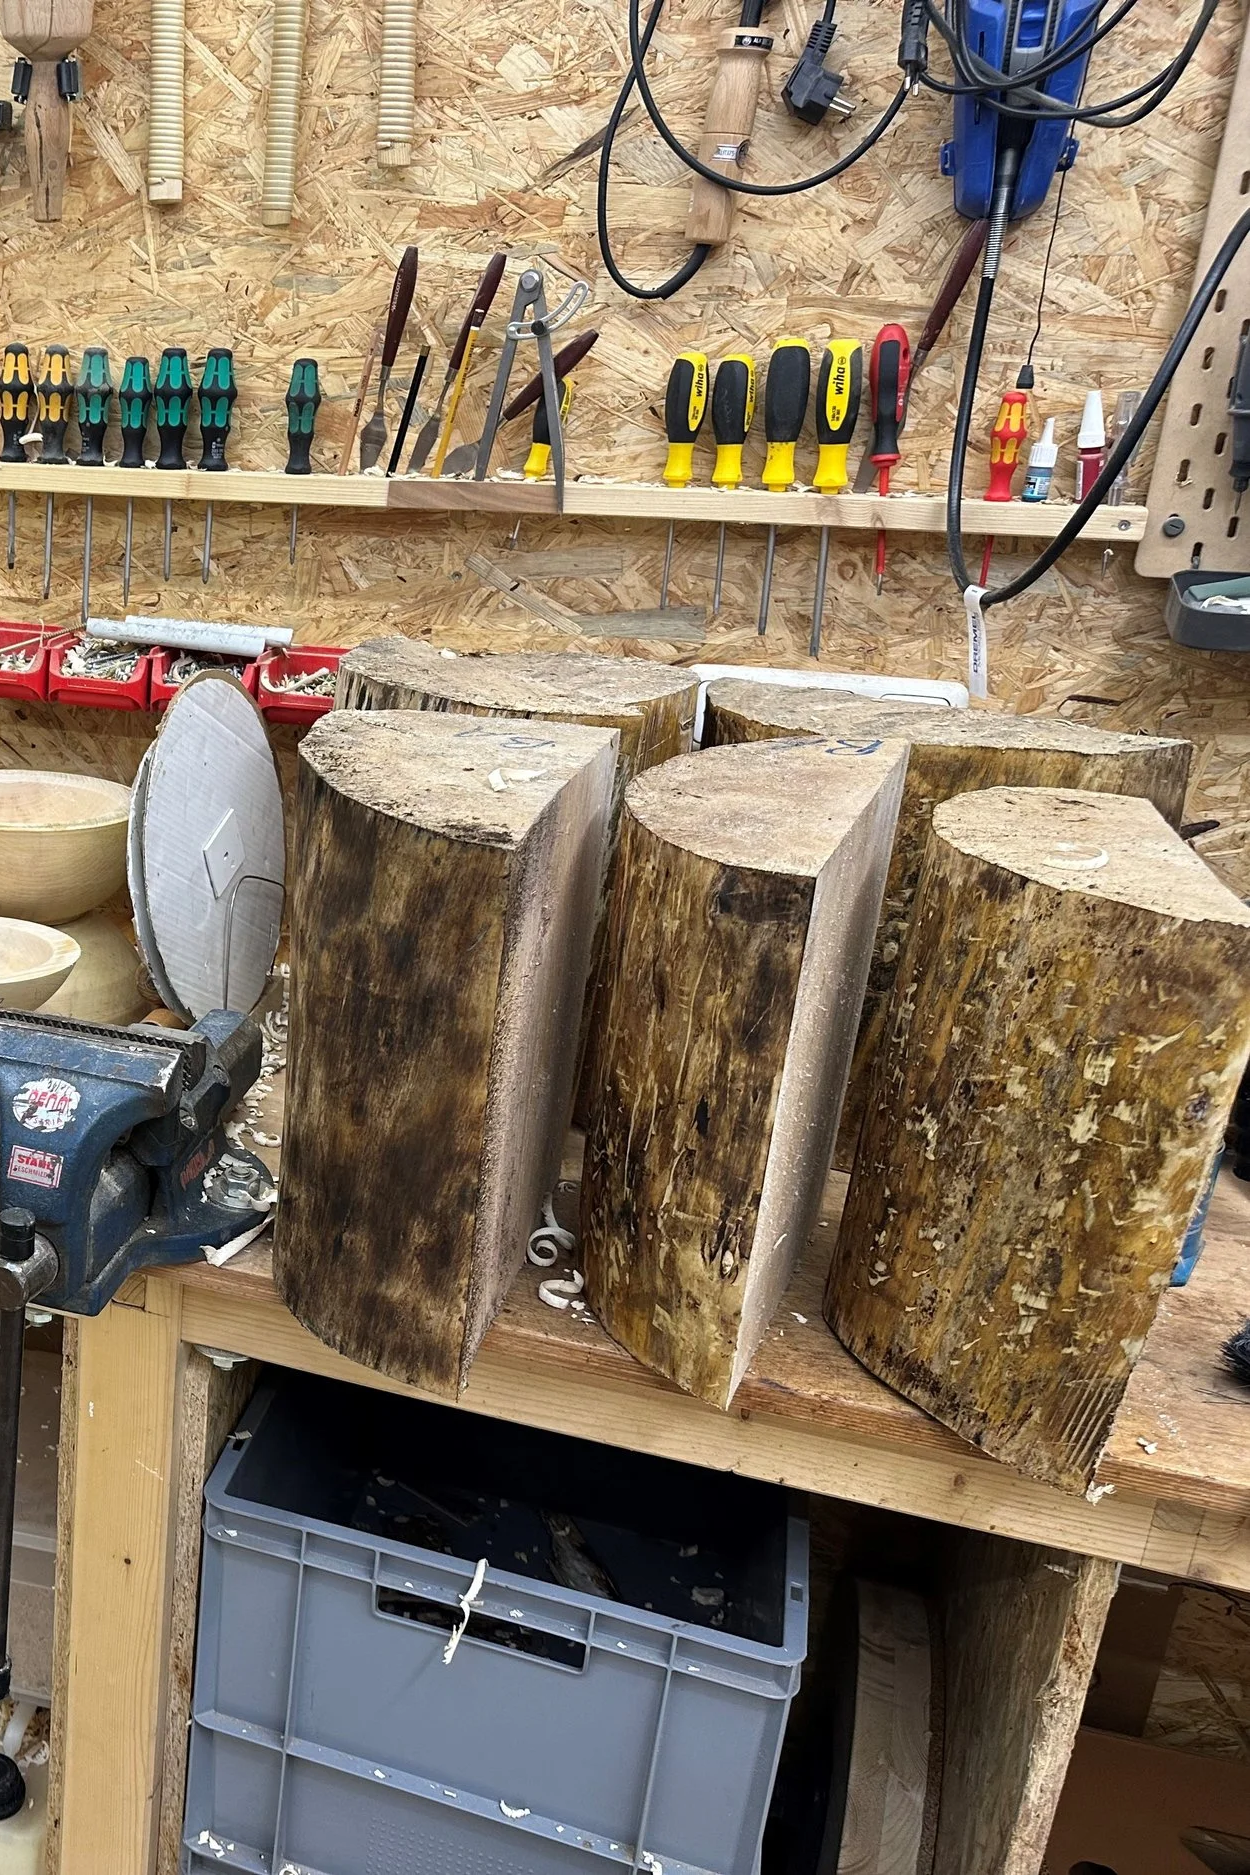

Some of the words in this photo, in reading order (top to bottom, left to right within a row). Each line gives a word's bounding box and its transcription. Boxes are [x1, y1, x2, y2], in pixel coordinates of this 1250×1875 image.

[695, 373, 705, 397] wiha
[833, 367, 846, 395] wiha
[971, 611, 979, 673] DREMEL
[17, 1154, 55, 1170] STAHL
